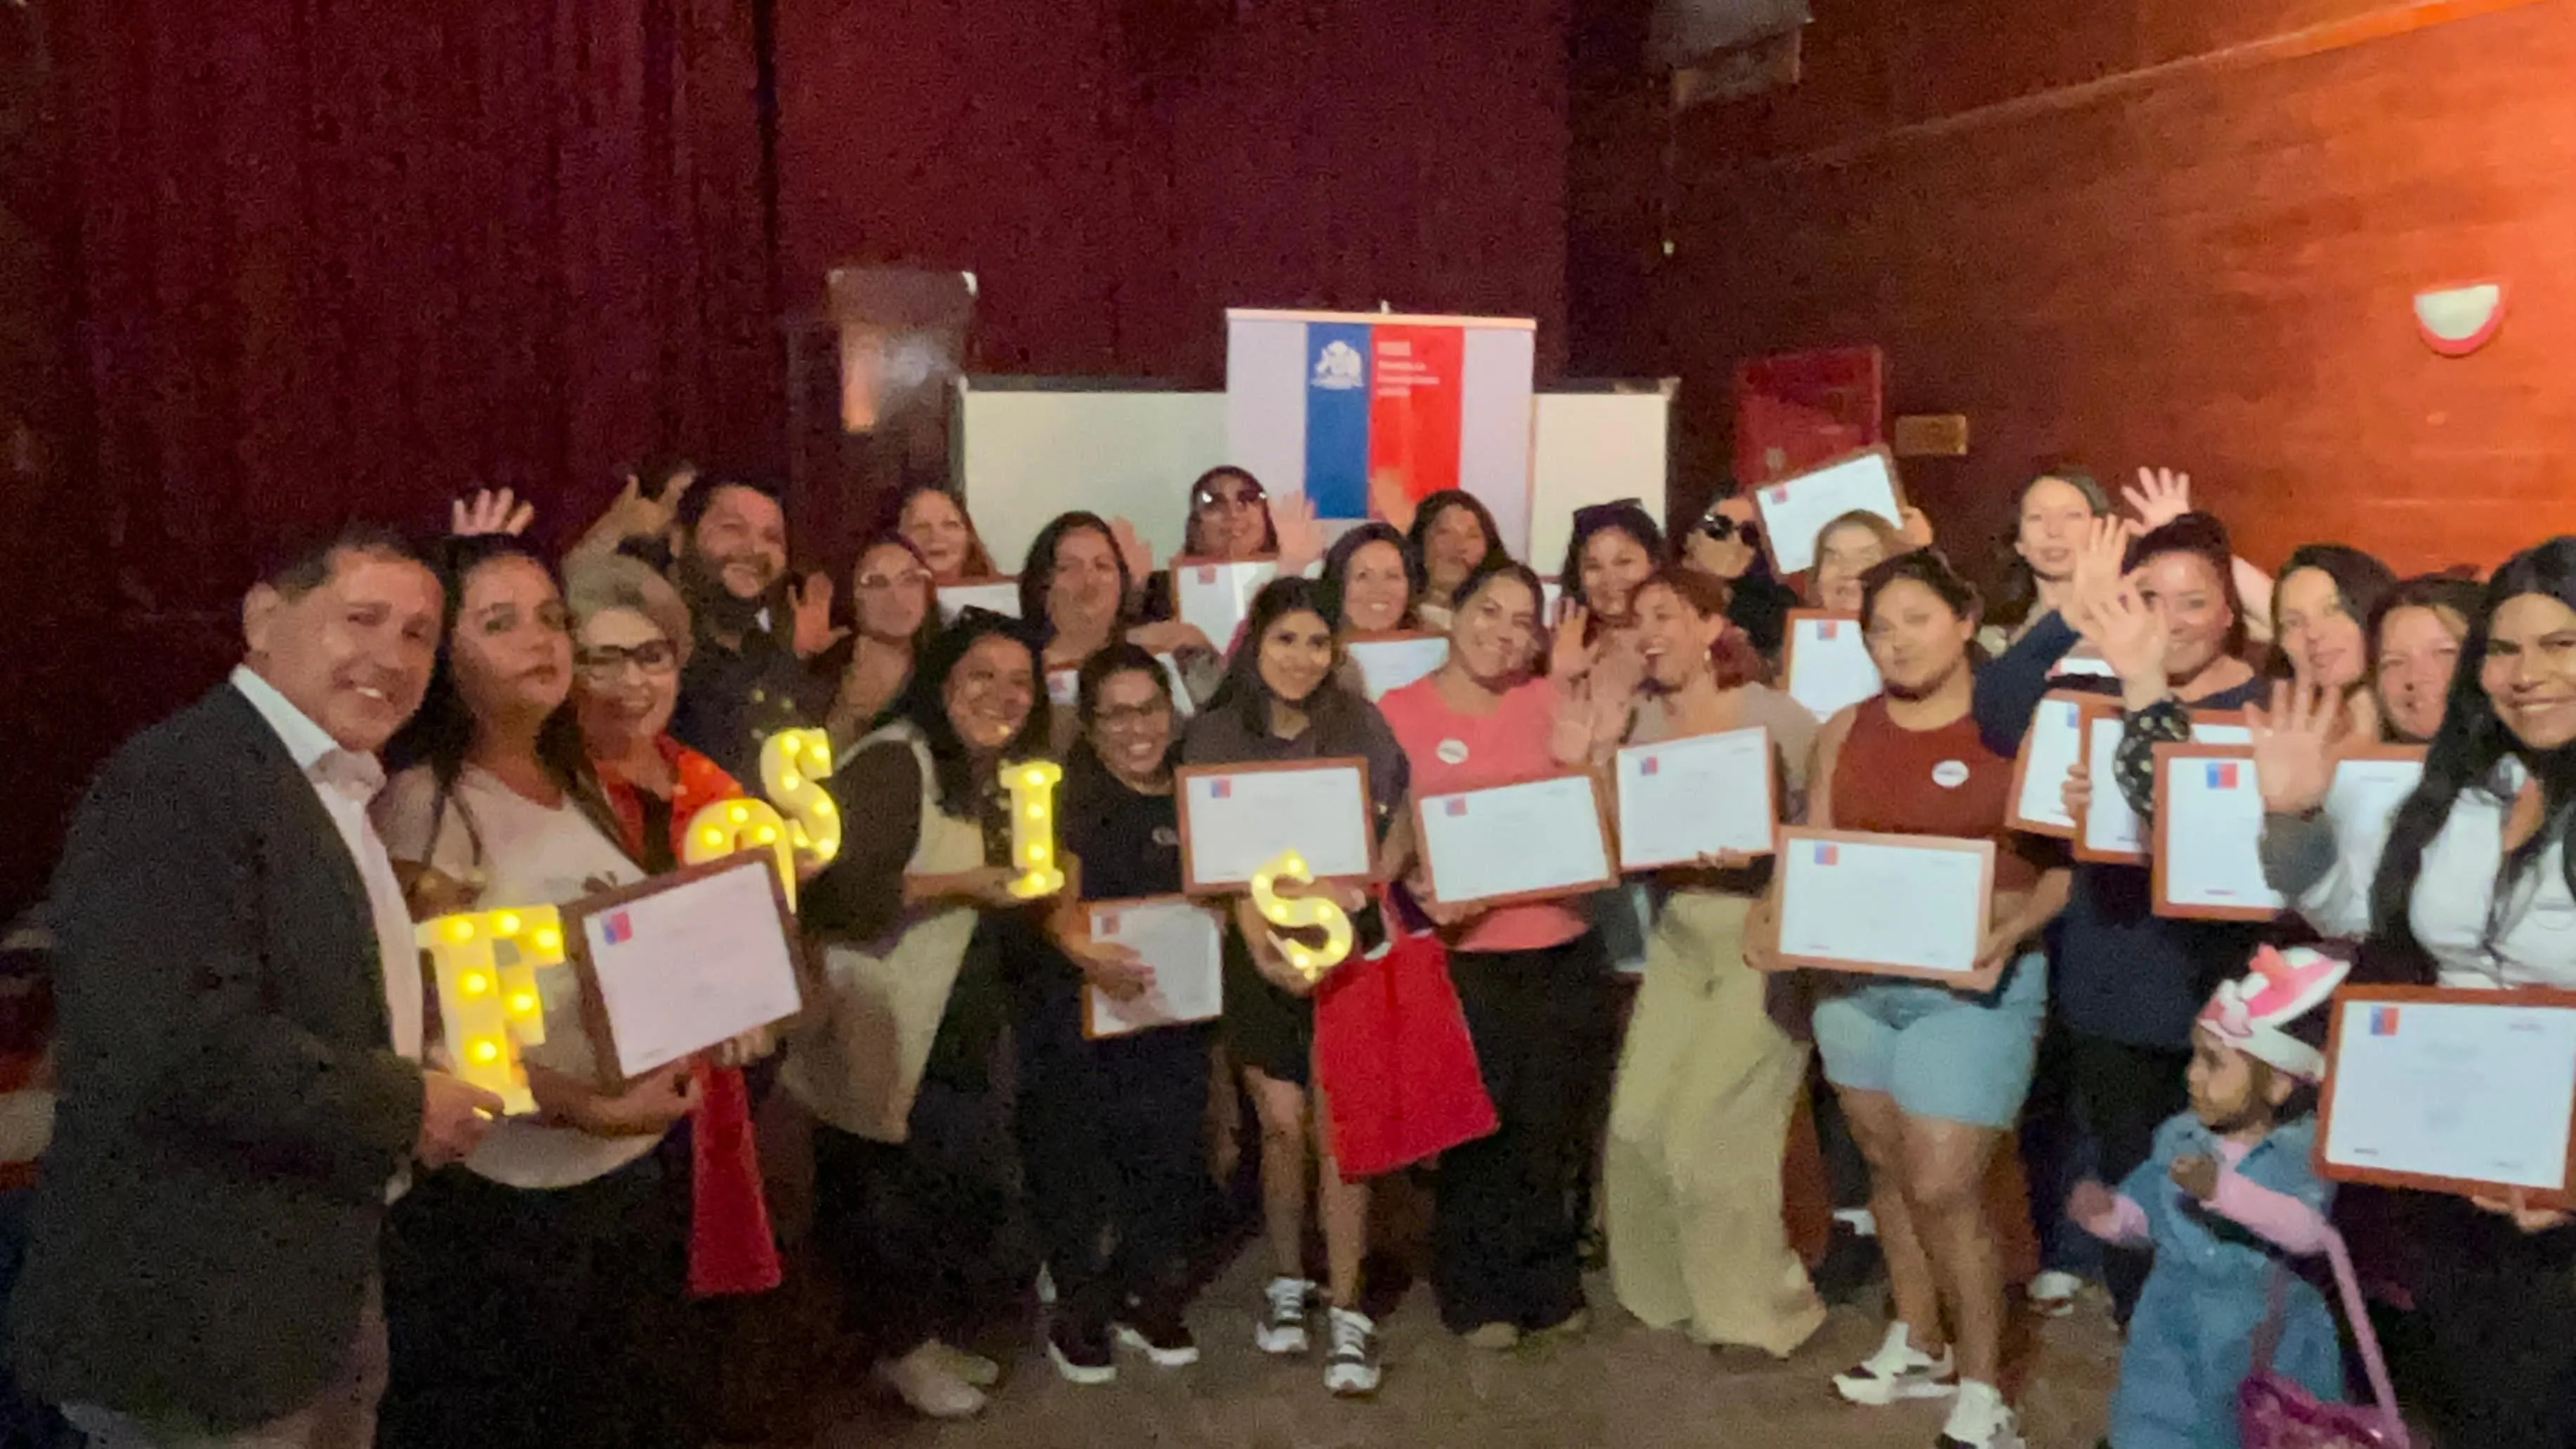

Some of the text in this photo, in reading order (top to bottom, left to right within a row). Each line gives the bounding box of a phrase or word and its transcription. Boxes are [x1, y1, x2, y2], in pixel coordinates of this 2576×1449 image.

[760, 727, 841, 863] S
[1251, 846, 1353, 971] S
[415, 904, 565, 1119] F
